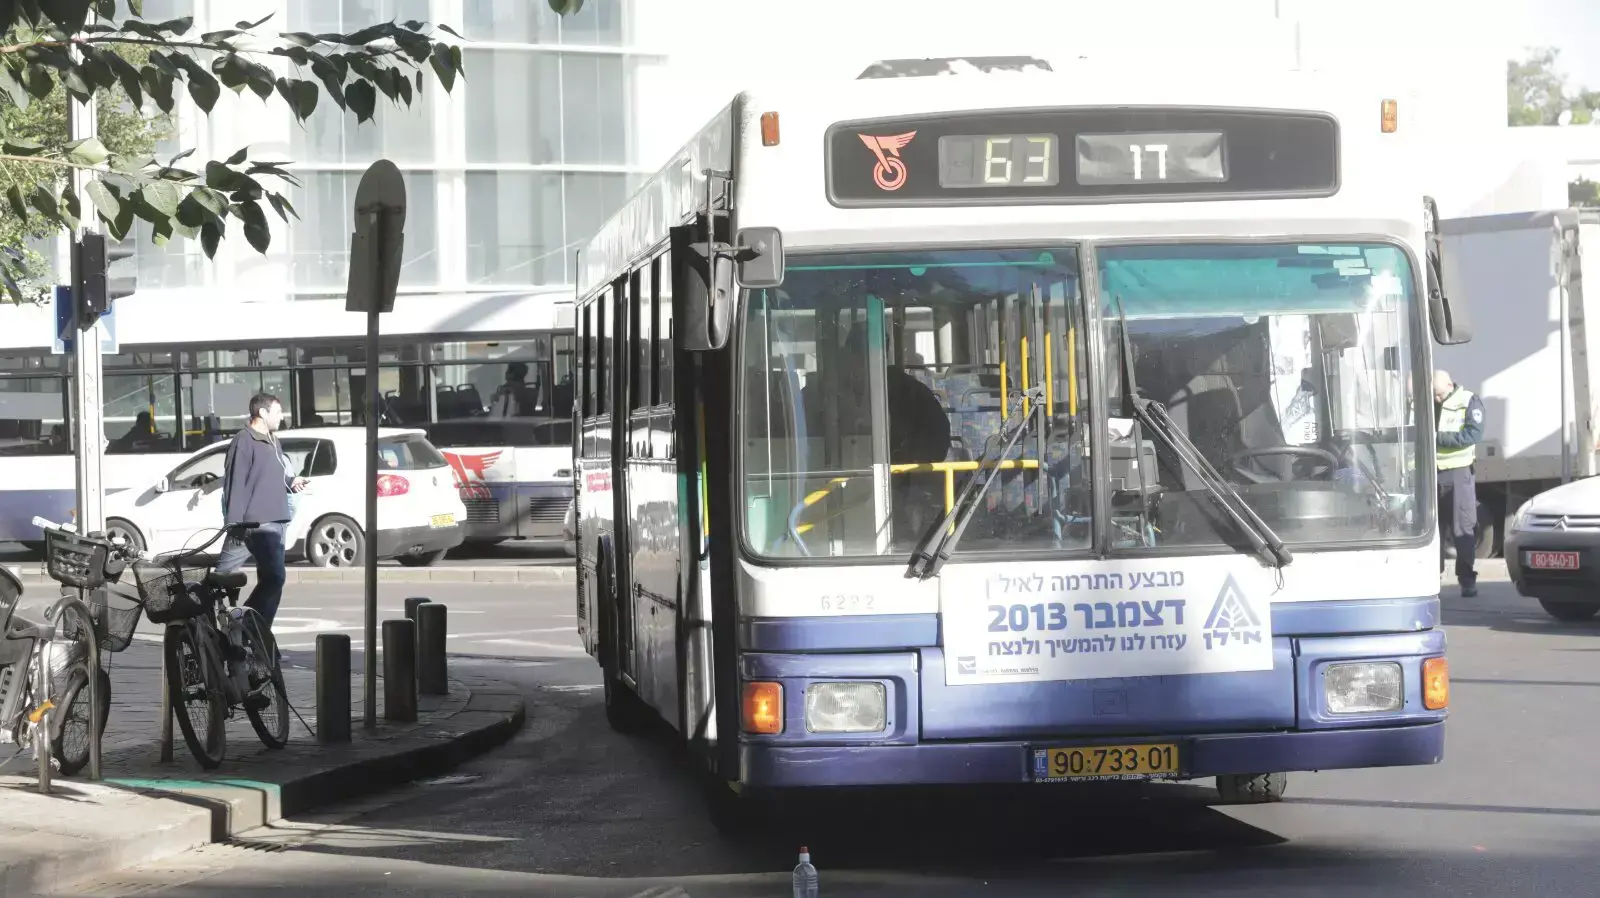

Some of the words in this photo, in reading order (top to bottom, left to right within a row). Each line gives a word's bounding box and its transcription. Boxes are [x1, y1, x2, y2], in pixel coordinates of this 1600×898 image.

[985, 137, 1050, 183] 63
[1051, 573, 1123, 592] התרמה
[1129, 570, 1185, 590] מבצע
[987, 602, 1068, 633] 2013
[1073, 598, 1186, 629] דצמבר
[988, 636, 1041, 656] ולנצח
[1044, 634, 1116, 658] להמשיך
[1120, 632, 1146, 651] לנו
[1150, 633, 1187, 651] עזרו
[1203, 628, 1262, 650] אילן
[1037, 757, 1046, 769] IL
